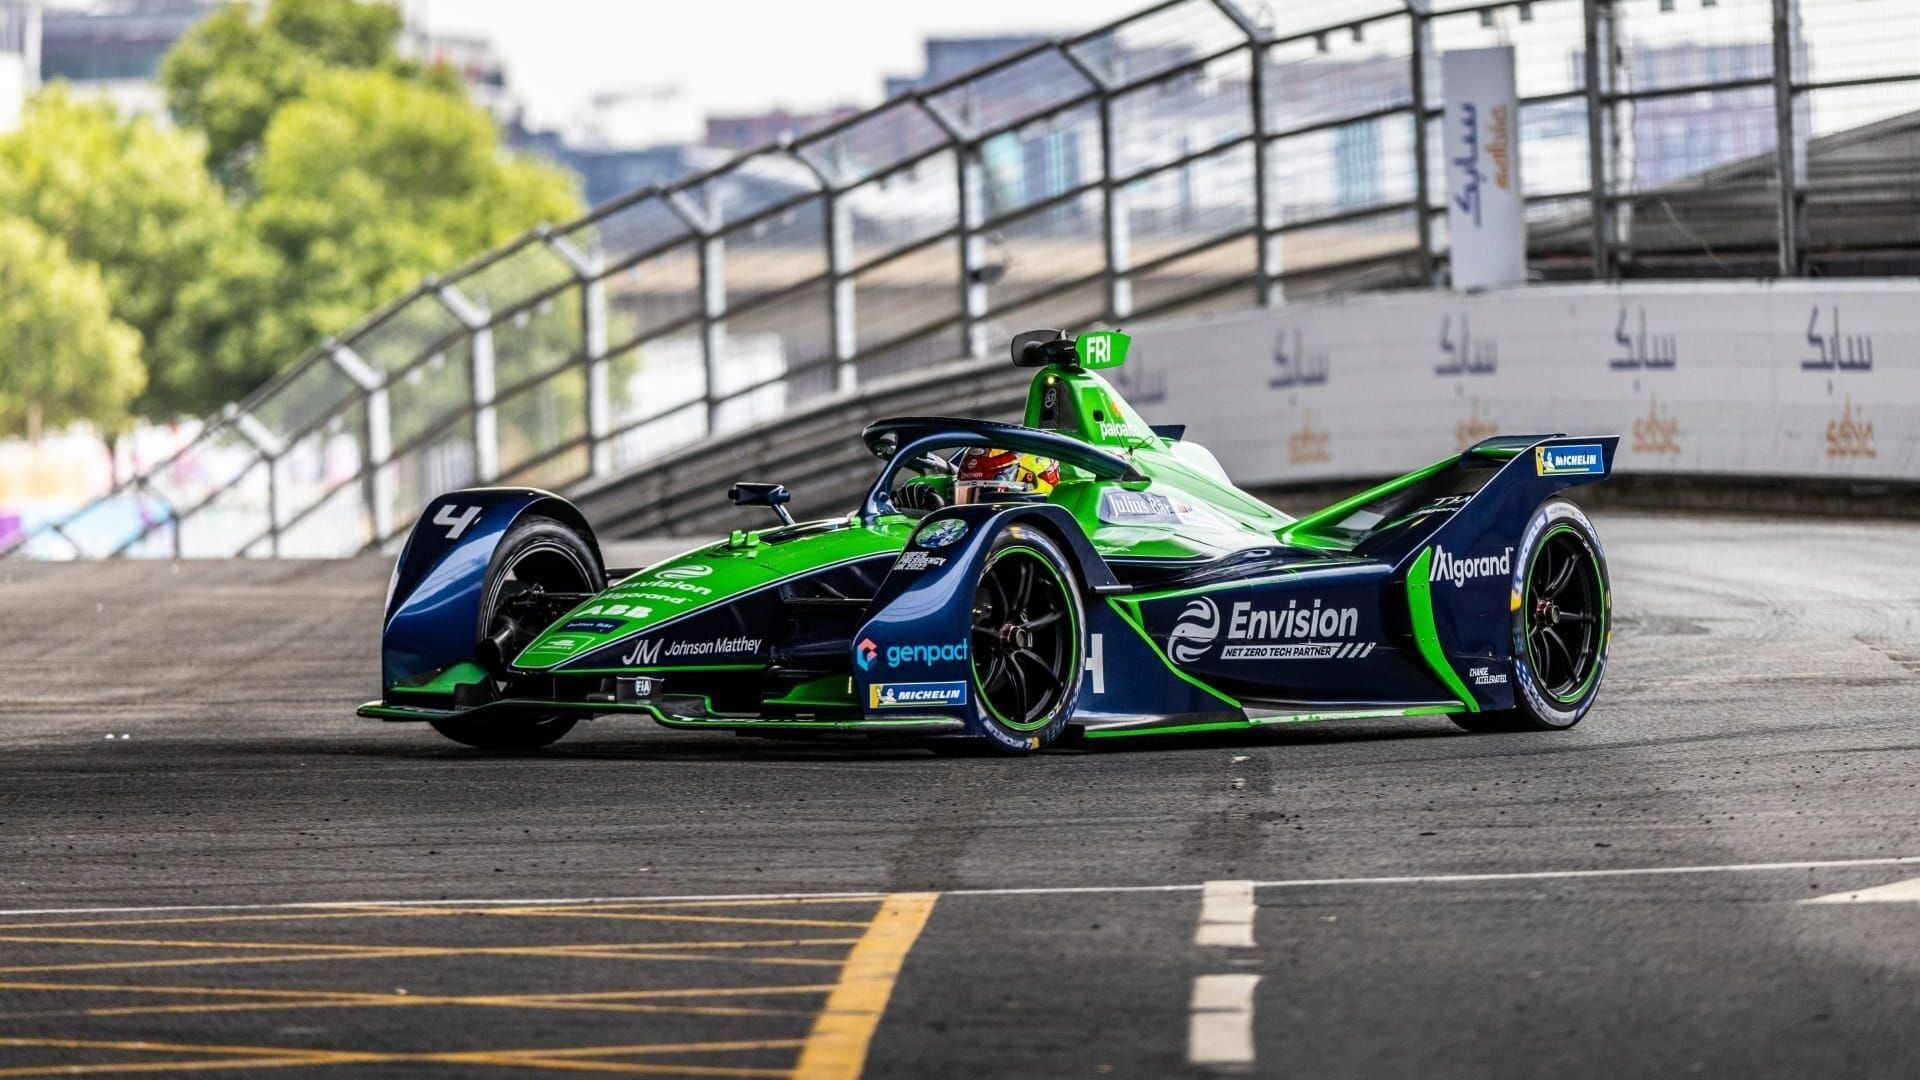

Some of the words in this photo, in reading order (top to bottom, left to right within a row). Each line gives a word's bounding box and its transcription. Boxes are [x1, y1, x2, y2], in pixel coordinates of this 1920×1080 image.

[1086, 335, 1111, 364] FRI
[1609, 305, 1676, 393] سابك
[1801, 305, 1873, 395] سابك
[1555, 454, 1597, 466] MICHELIN
[433, 505, 482, 539] 4
[1429, 545, 1511, 588] Algorand
[573, 604, 653, 618] ABB
[1228, 599, 1358, 639] Envision
[622, 638, 665, 665] JM
[664, 640, 713, 656] Johnson
[714, 636, 762, 655] Matthey
[886, 638, 968, 668] genpact
[1225, 647, 1243, 657] NET
[1244, 647, 1268, 657] ZERO
[1270, 647, 1292, 657] TECH
[1293, 646, 1332, 656] PARTNER
[635, 679, 651, 692] FIA
[898, 689, 961, 700] MICHELIN
